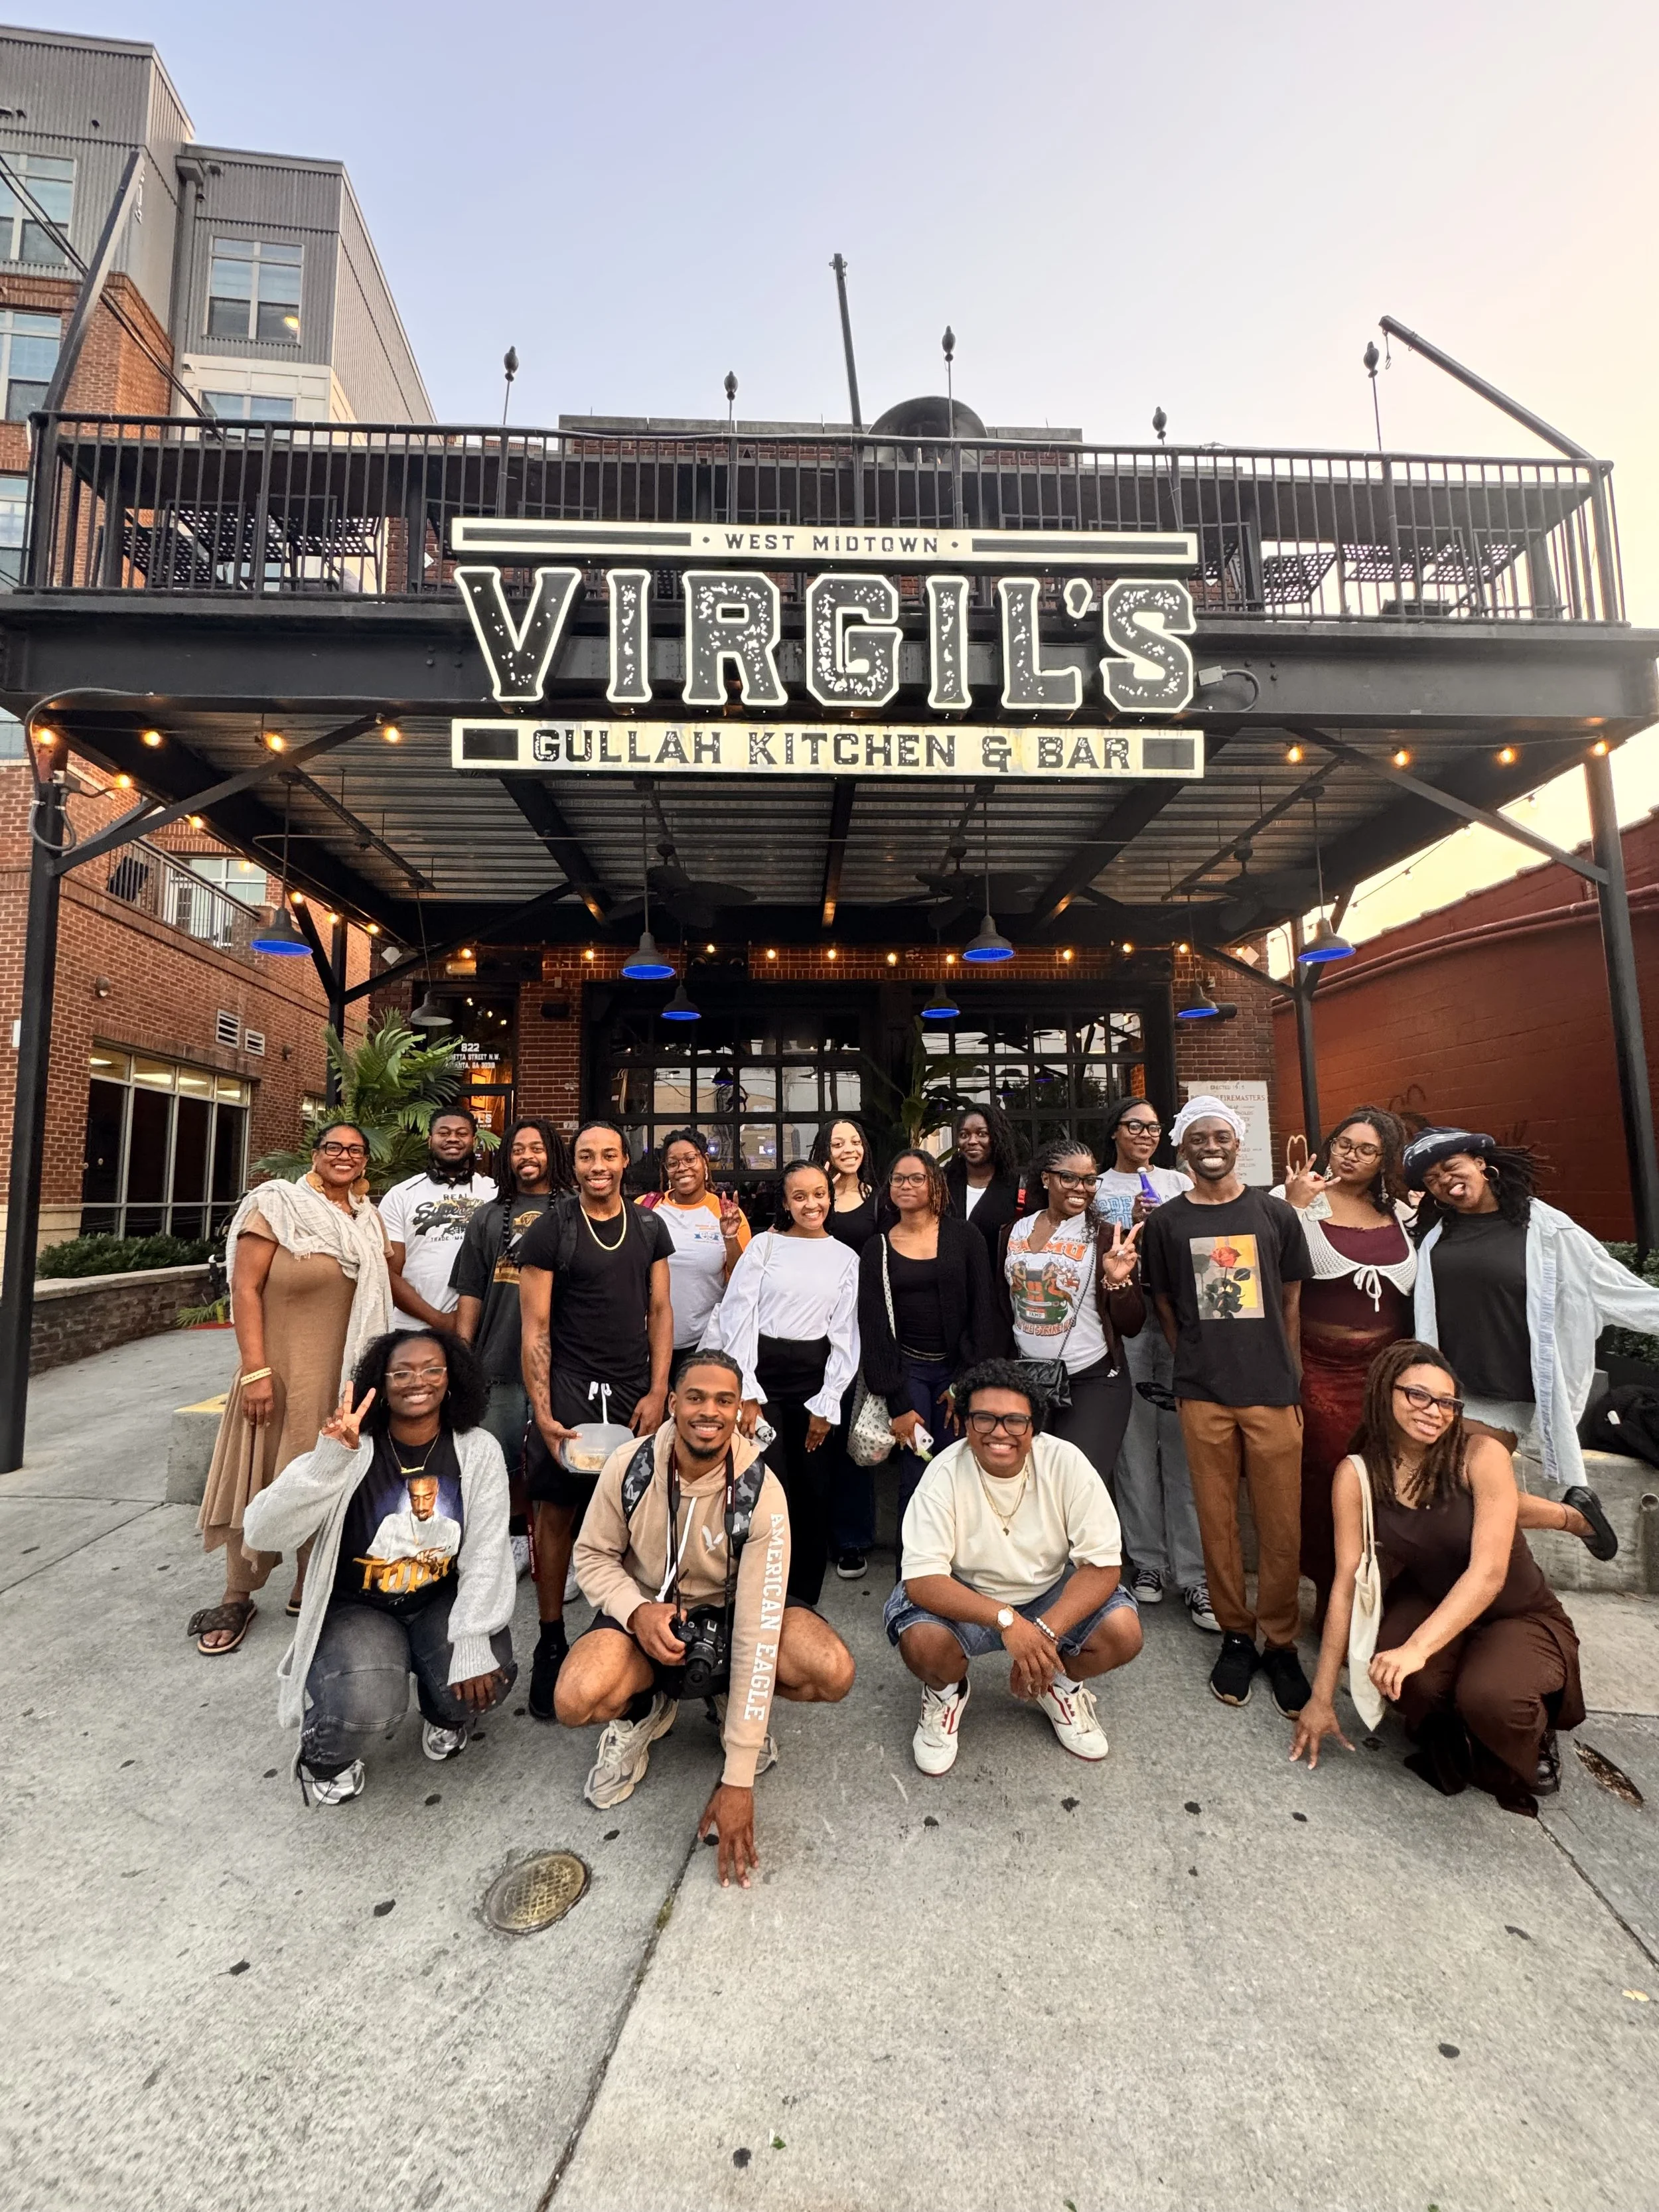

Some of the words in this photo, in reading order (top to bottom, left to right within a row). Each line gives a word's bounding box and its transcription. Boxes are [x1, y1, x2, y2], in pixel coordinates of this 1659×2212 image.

[724, 532, 796, 551] WEST
[813, 535, 939, 555] MIDTOWN
[454, 566, 1197, 714] VIRGIL'S
[532, 727, 722, 765] GULLAH
[748, 731, 957, 770] KITCHEN
[981, 735, 1012, 773] &
[1037, 734, 1129, 771] BAR
[461, 1043, 480, 1052] 822
[759, 1512, 786, 1631] AMERICAN
[743, 1641, 778, 1722] EAGLE
